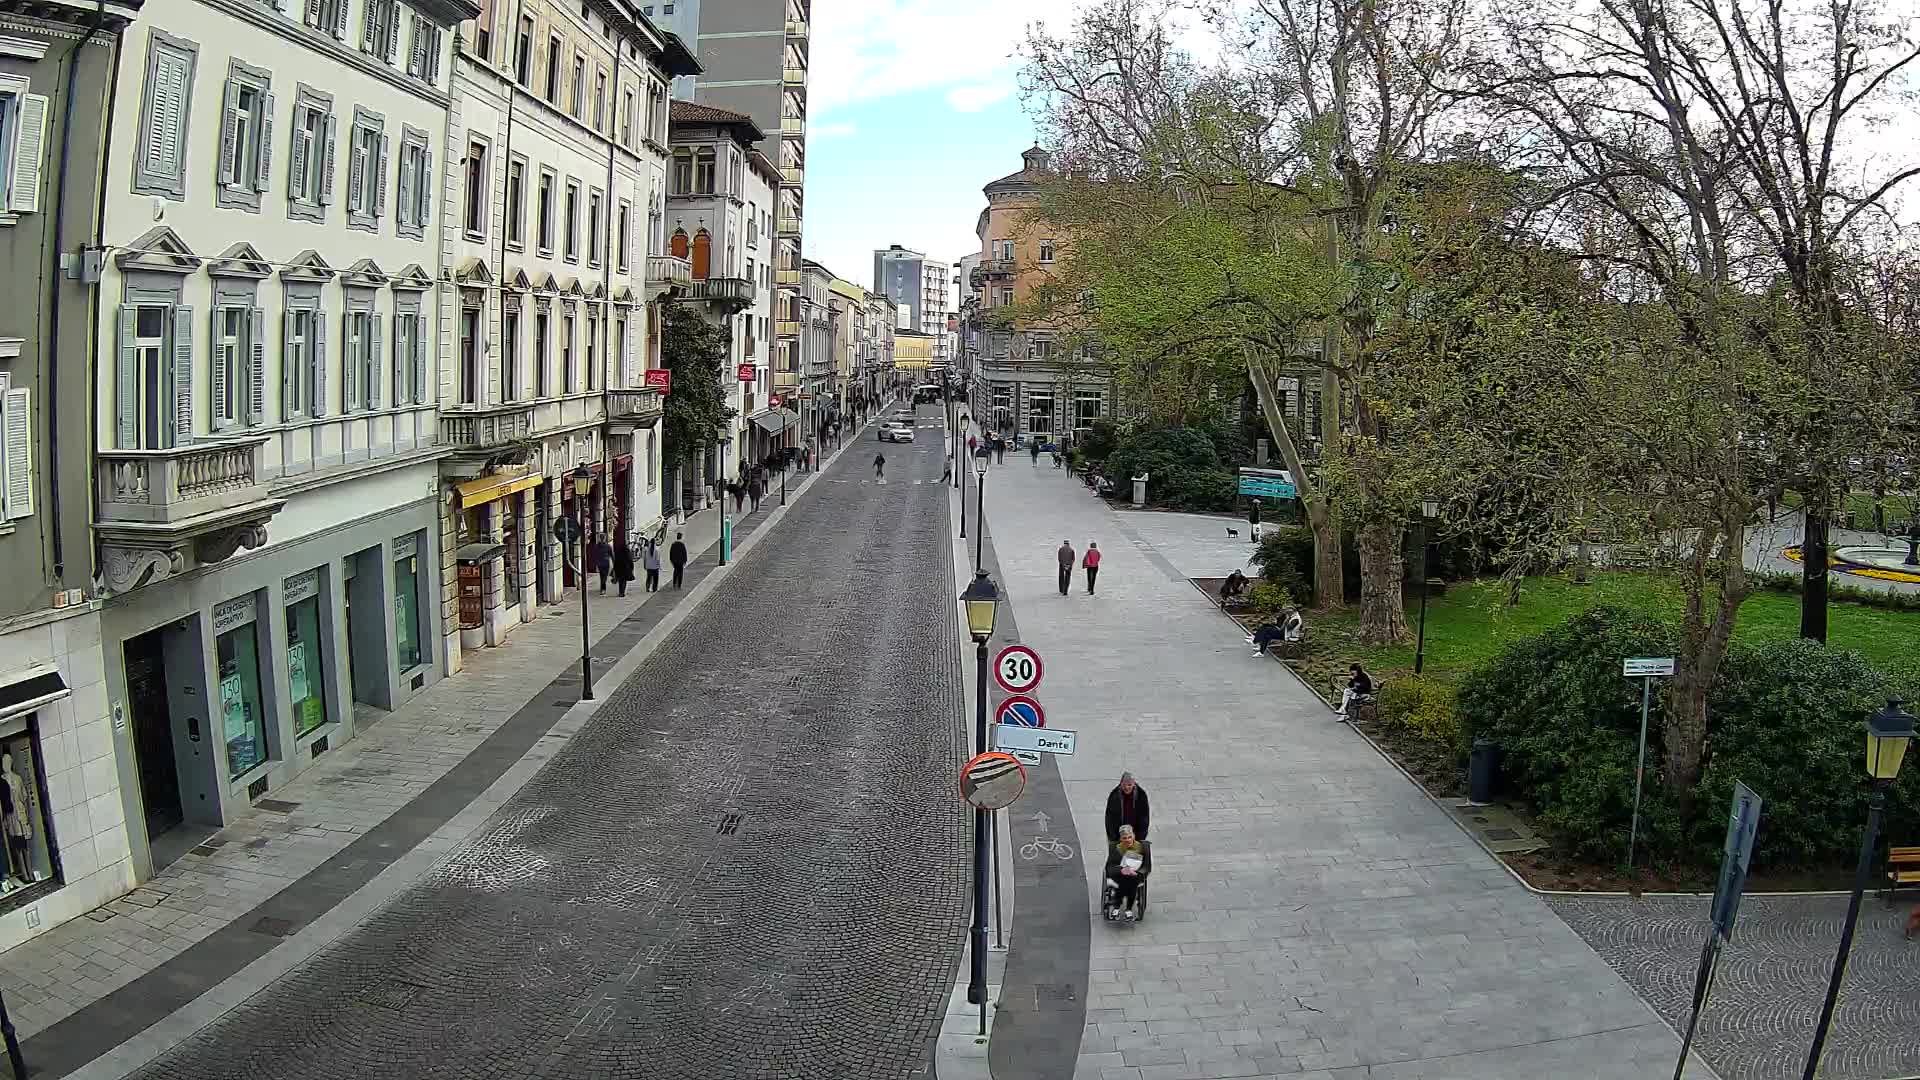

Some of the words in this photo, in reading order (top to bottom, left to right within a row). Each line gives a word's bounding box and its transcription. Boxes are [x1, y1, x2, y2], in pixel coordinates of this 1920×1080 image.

[1005, 658, 1032, 680] 30
[222, 677, 240, 700] 130
[1038, 738, 1069, 749] Dante
